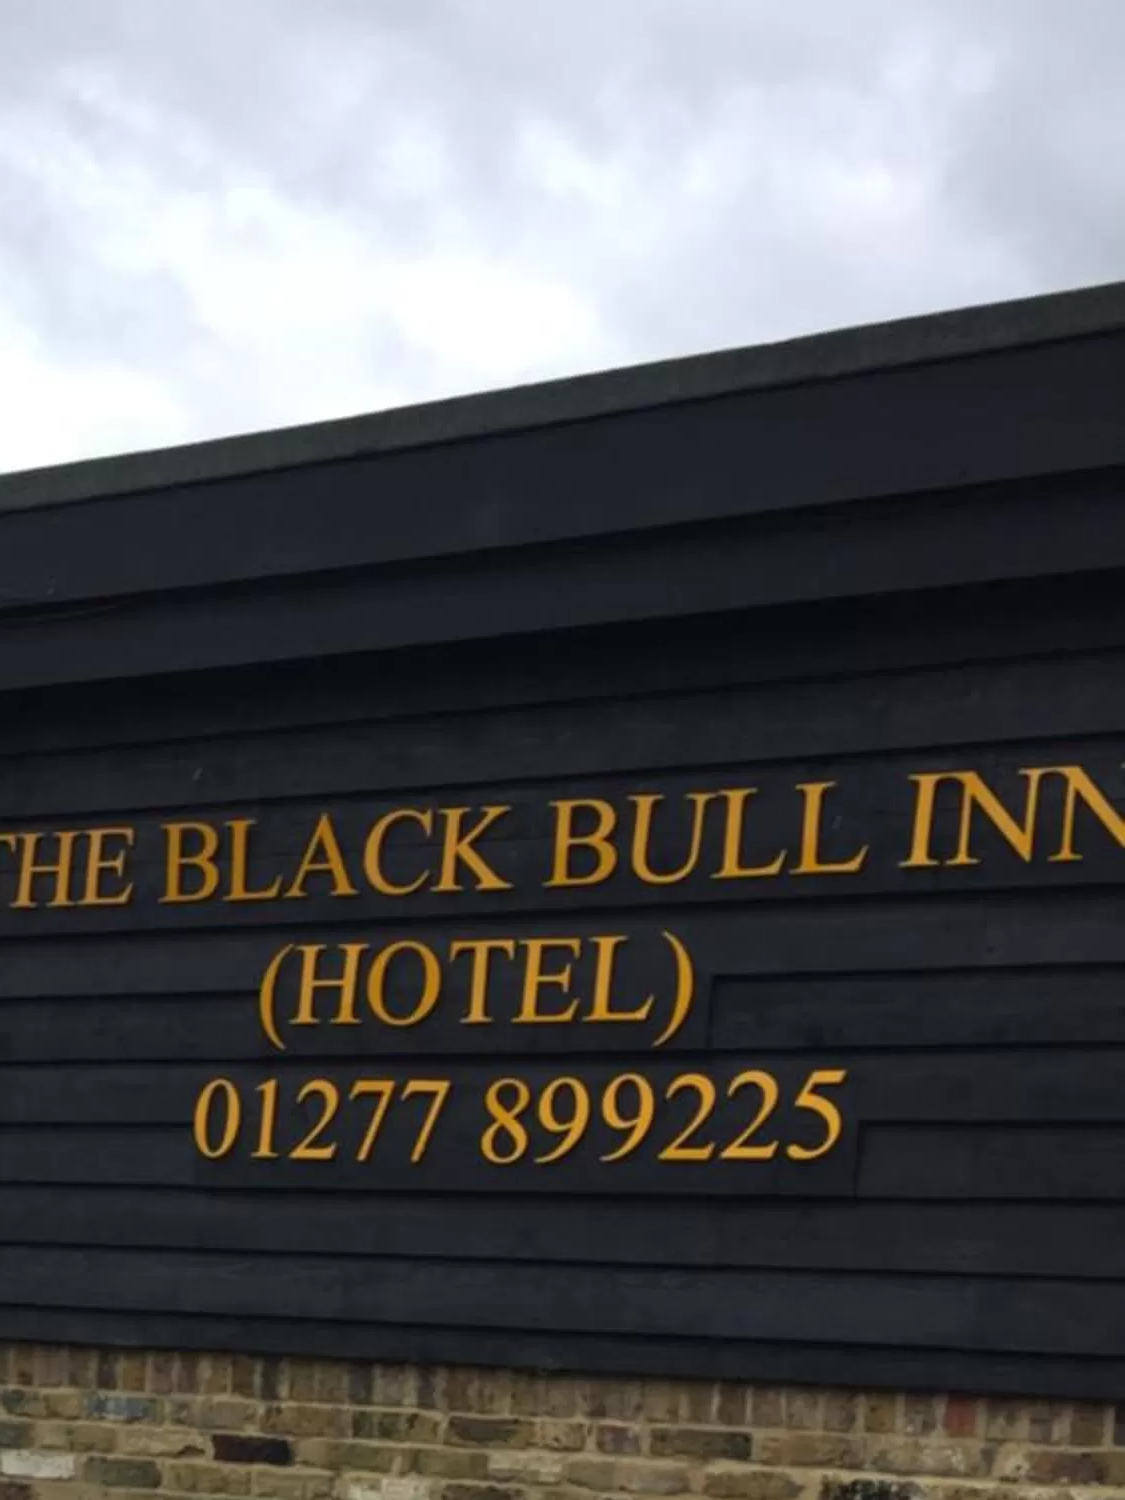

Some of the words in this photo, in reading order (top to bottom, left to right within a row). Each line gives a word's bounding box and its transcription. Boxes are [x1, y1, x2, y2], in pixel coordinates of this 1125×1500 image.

[159, 805, 514, 903] BLACK
[543, 781, 870, 888] BULL
[897, 765, 1125, 868] INN
[258, 931, 695, 1049] (HOTEL)
[193, 1077, 452, 1164] 01277
[479, 1069, 847, 1165] 899225
